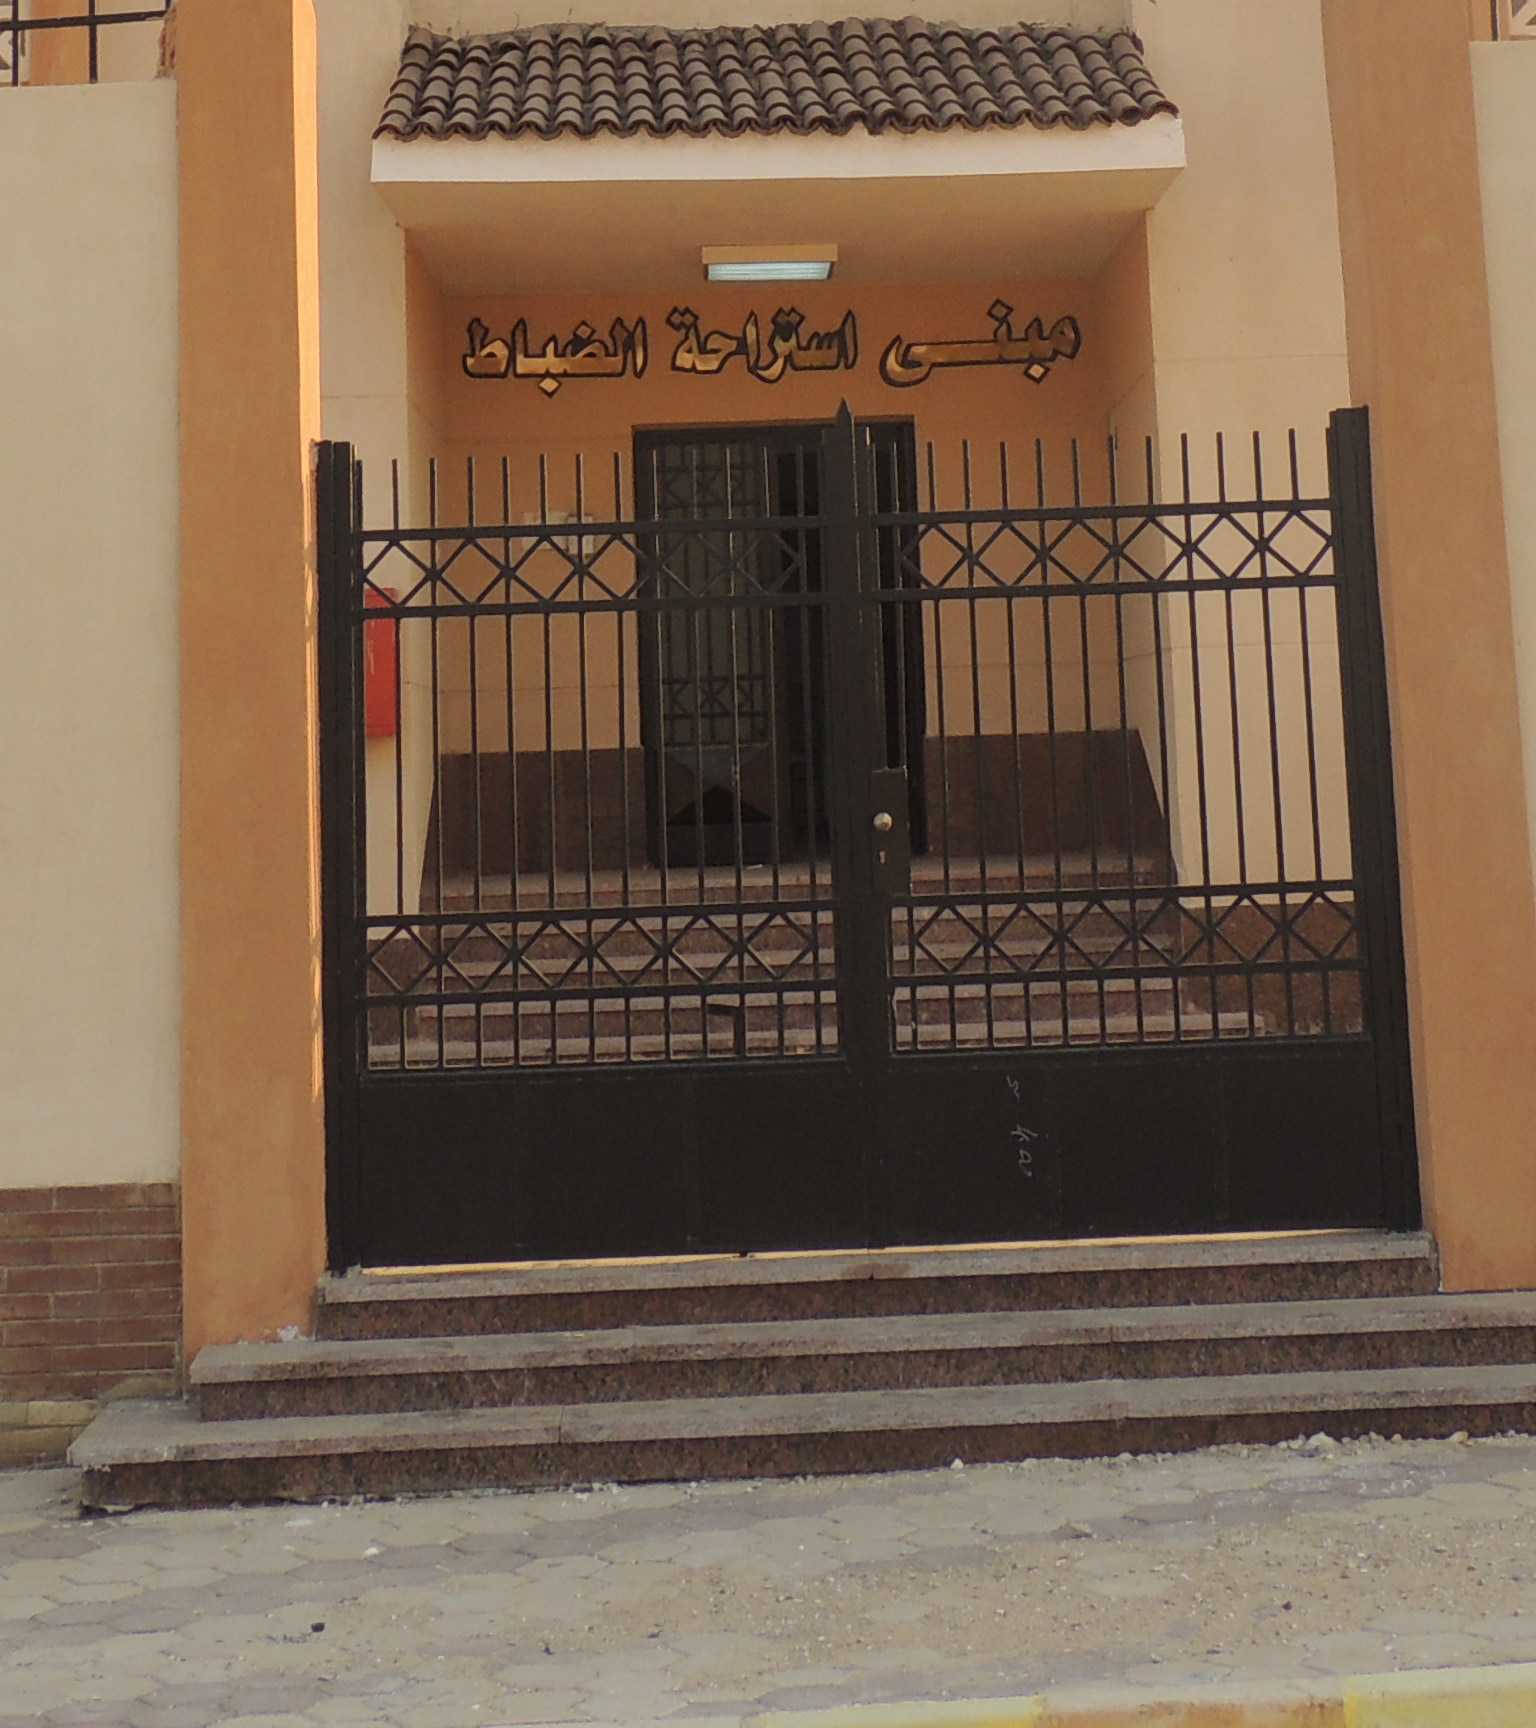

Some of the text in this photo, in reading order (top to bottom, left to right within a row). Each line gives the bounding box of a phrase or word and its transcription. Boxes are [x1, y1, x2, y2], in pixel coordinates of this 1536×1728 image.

[463, 298, 1081, 398] مبنى استراحة الضباط
